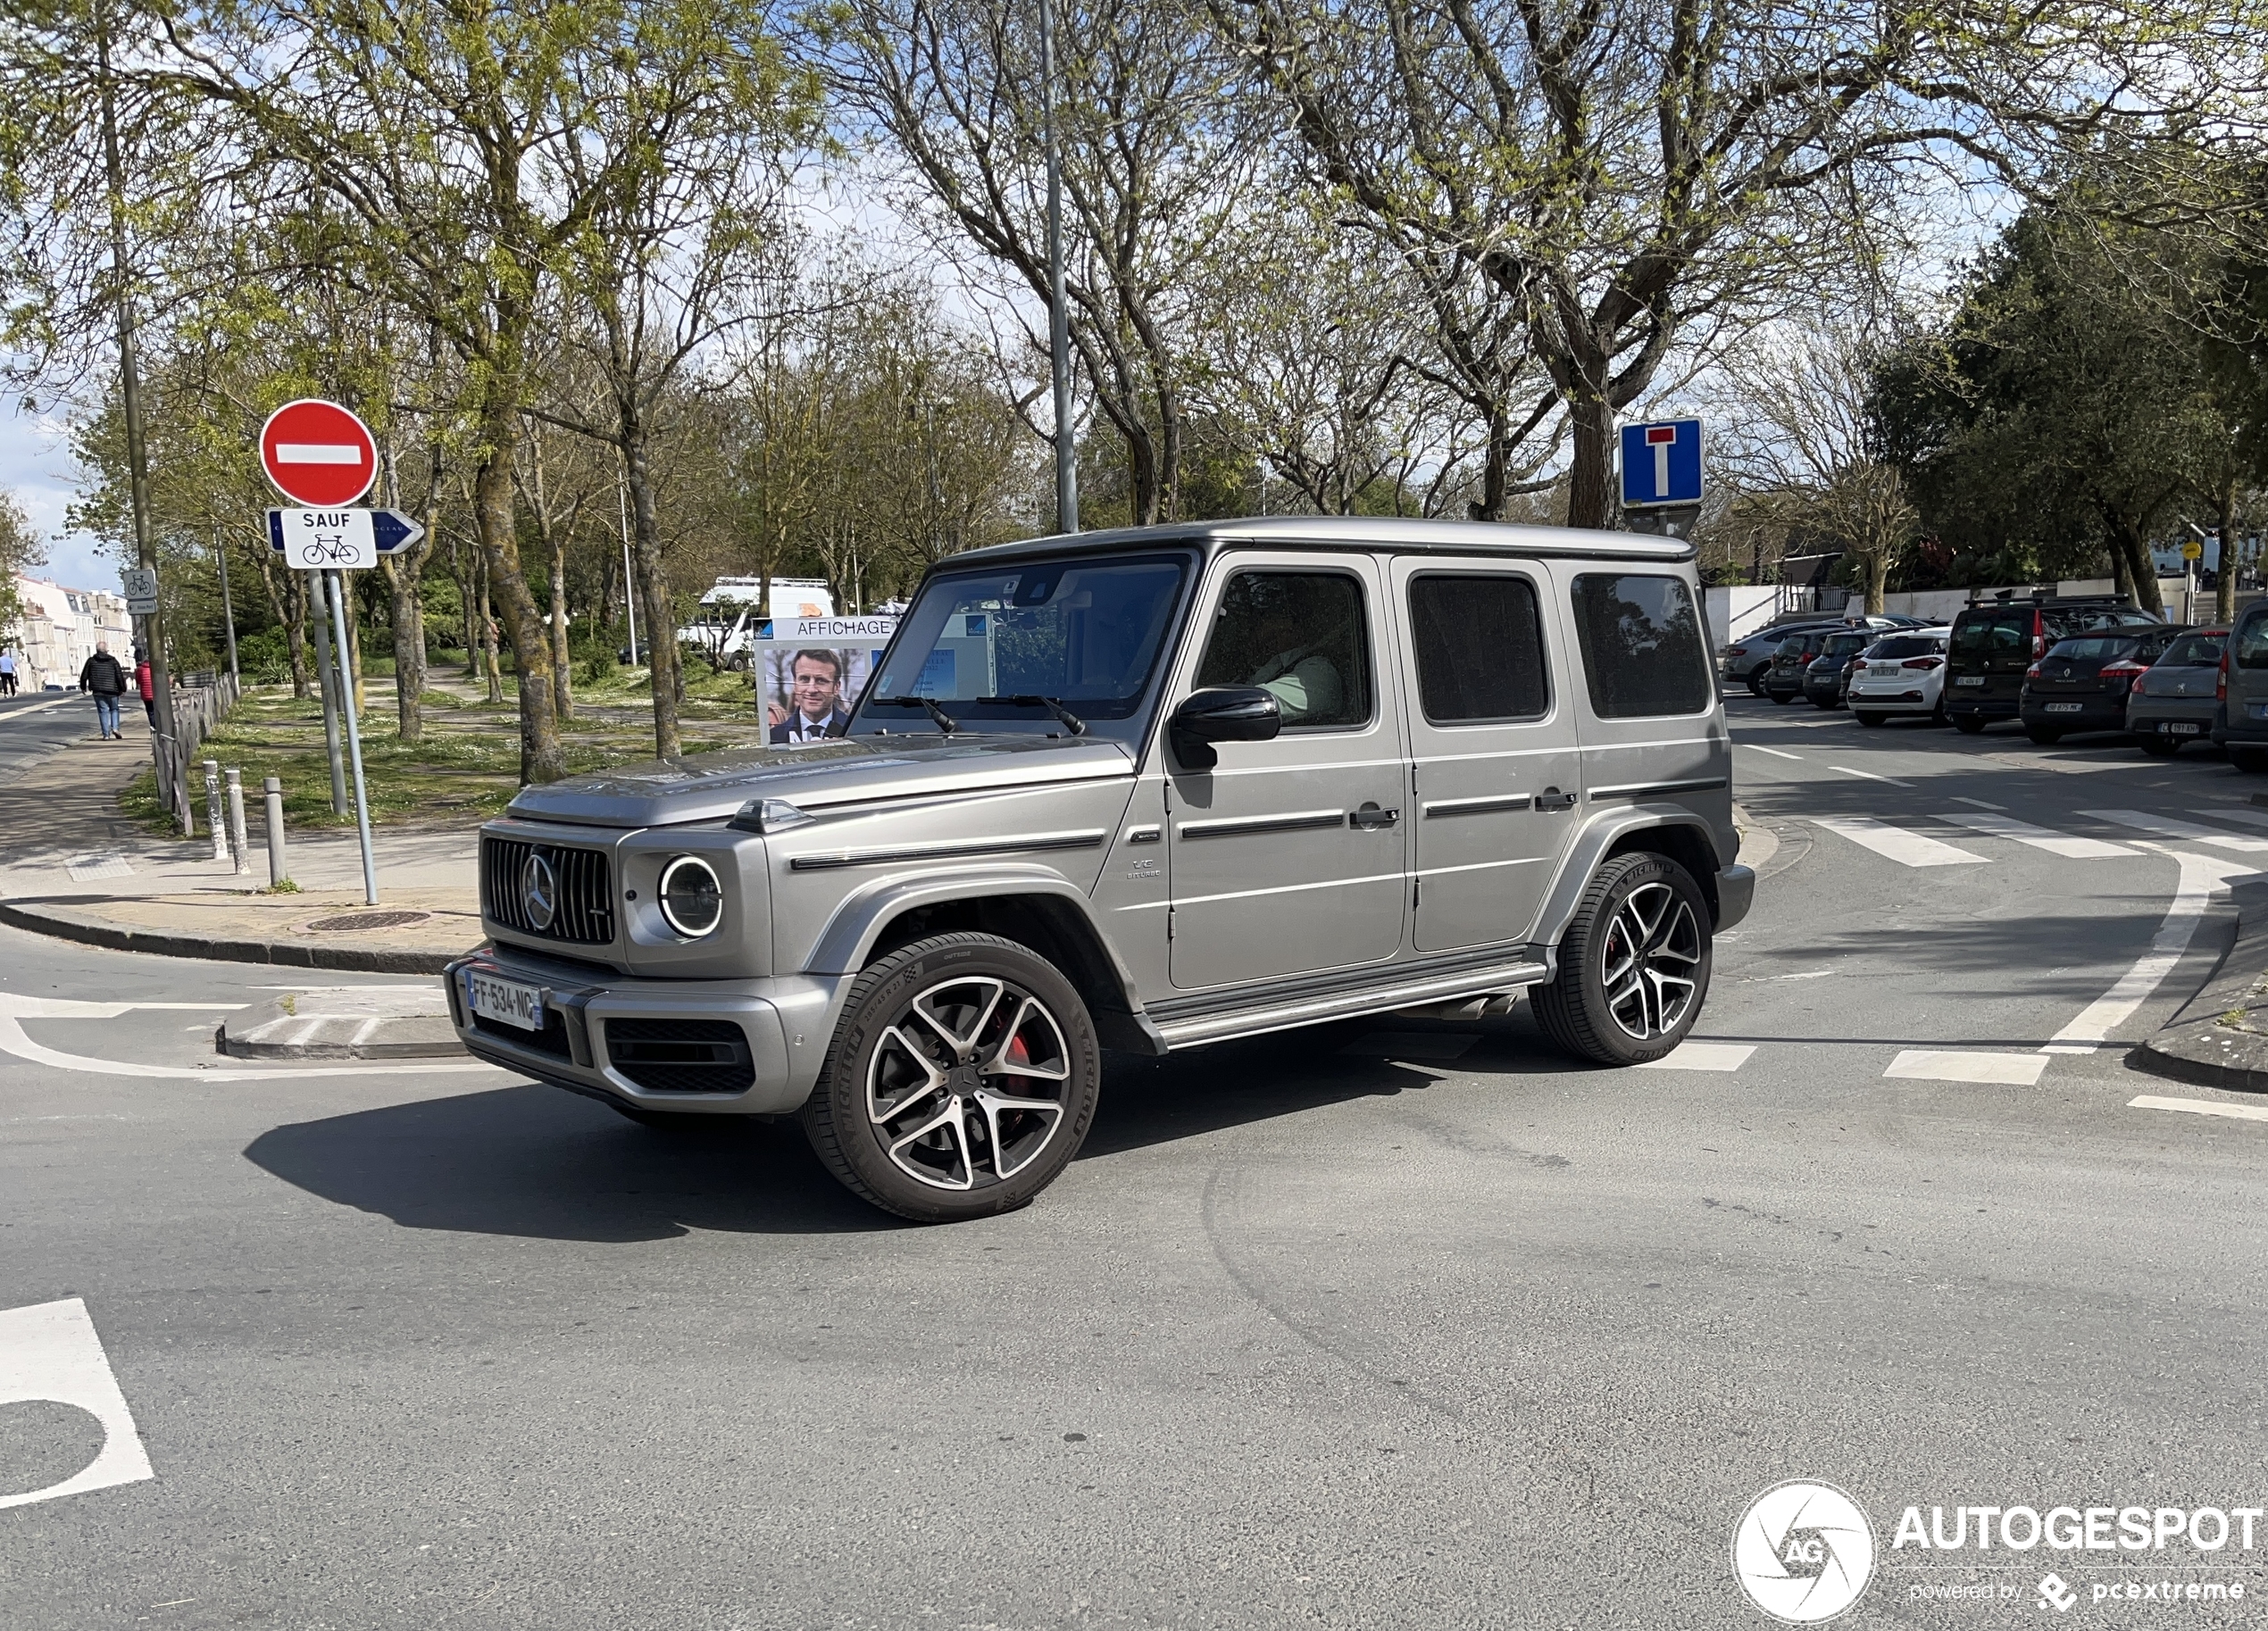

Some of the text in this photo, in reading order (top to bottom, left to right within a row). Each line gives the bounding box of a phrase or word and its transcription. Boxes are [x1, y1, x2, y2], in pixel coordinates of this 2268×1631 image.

[303, 512, 351, 528] SAUF
[797, 620, 891, 636] AFFICHAGE
[1127, 870, 1160, 879] BITURBO
[1626, 862, 1672, 882] MICHELIN
[943, 950, 972, 961] OUTSIDE
[838, 1027, 863, 1134] MICHELIN
[1075, 1036, 1095, 1136] MICHELIN
